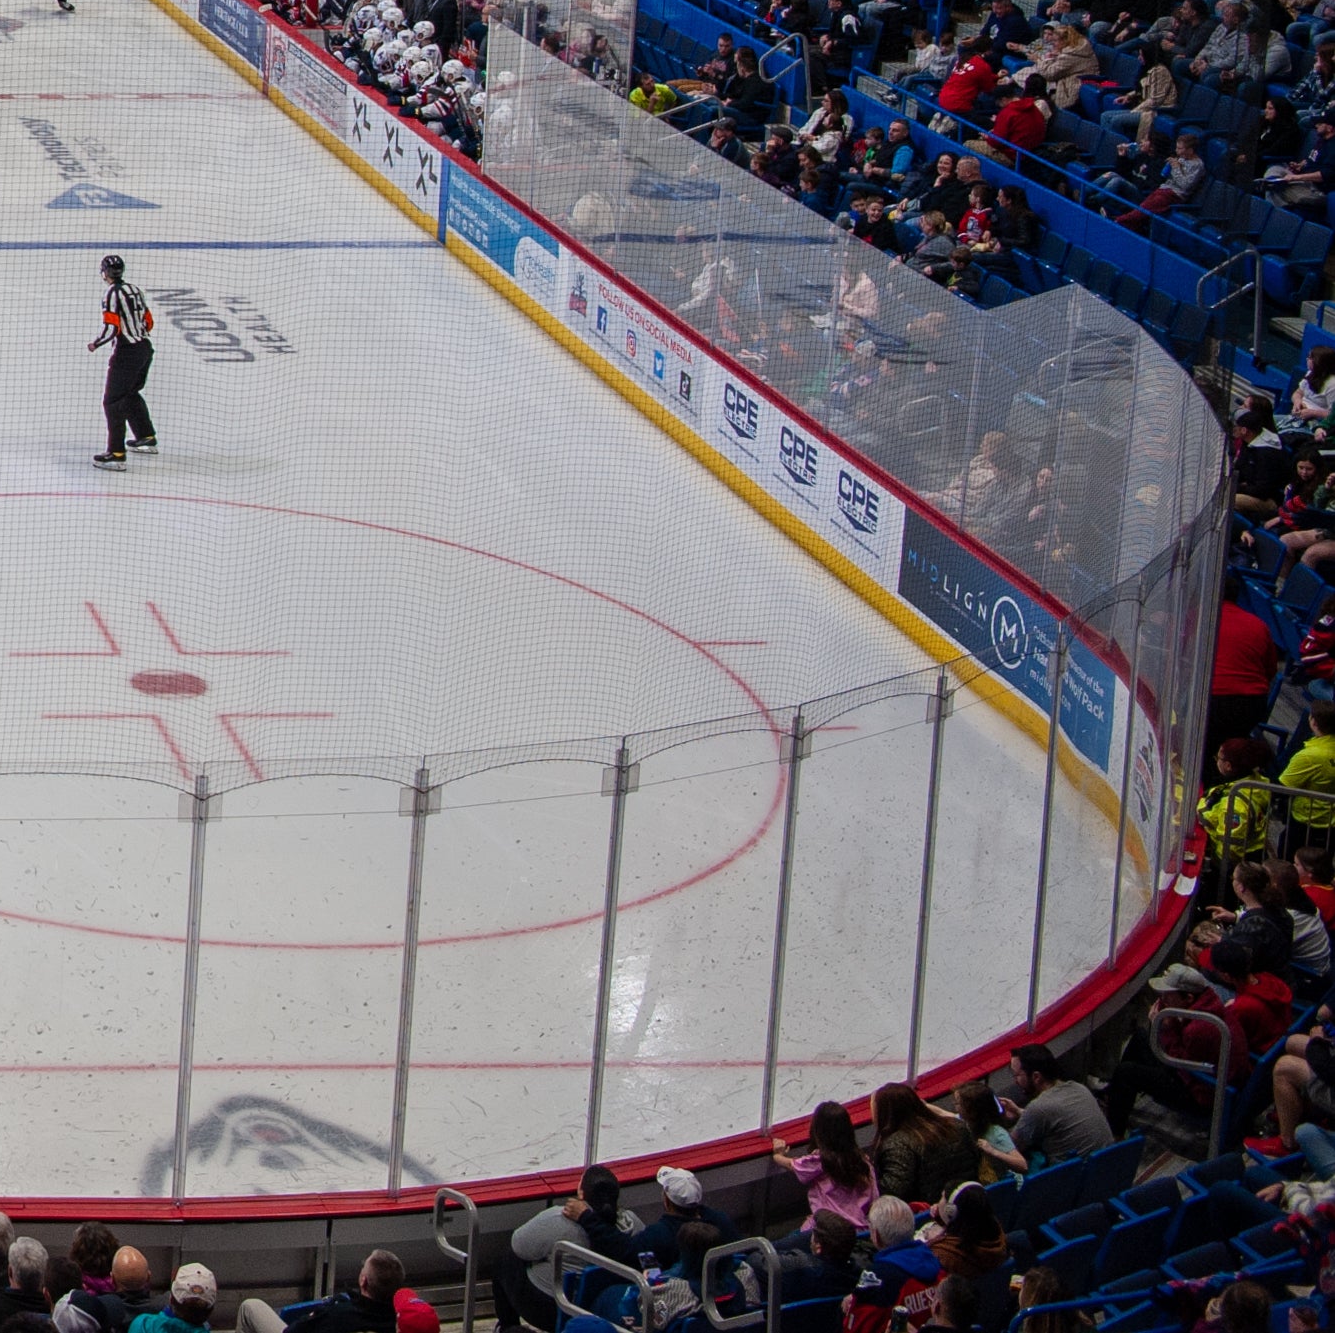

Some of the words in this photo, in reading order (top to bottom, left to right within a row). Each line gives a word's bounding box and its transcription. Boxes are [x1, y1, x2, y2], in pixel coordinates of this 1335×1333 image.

[598, 283, 627, 312] FOLLOW
[645, 317, 670, 349] SOCIAL
[671, 335, 693, 365] MEDIA
[724, 383, 758, 428] CPE
[724, 409, 757, 438] ELECTRIC
[779, 452, 817, 487] ELECTRIC
[780, 425, 818, 473] CPE
[837, 469, 879, 520] CPE
[837, 498, 877, 535] ELECTRIC
[1081, 693, 1106, 721] Pack
